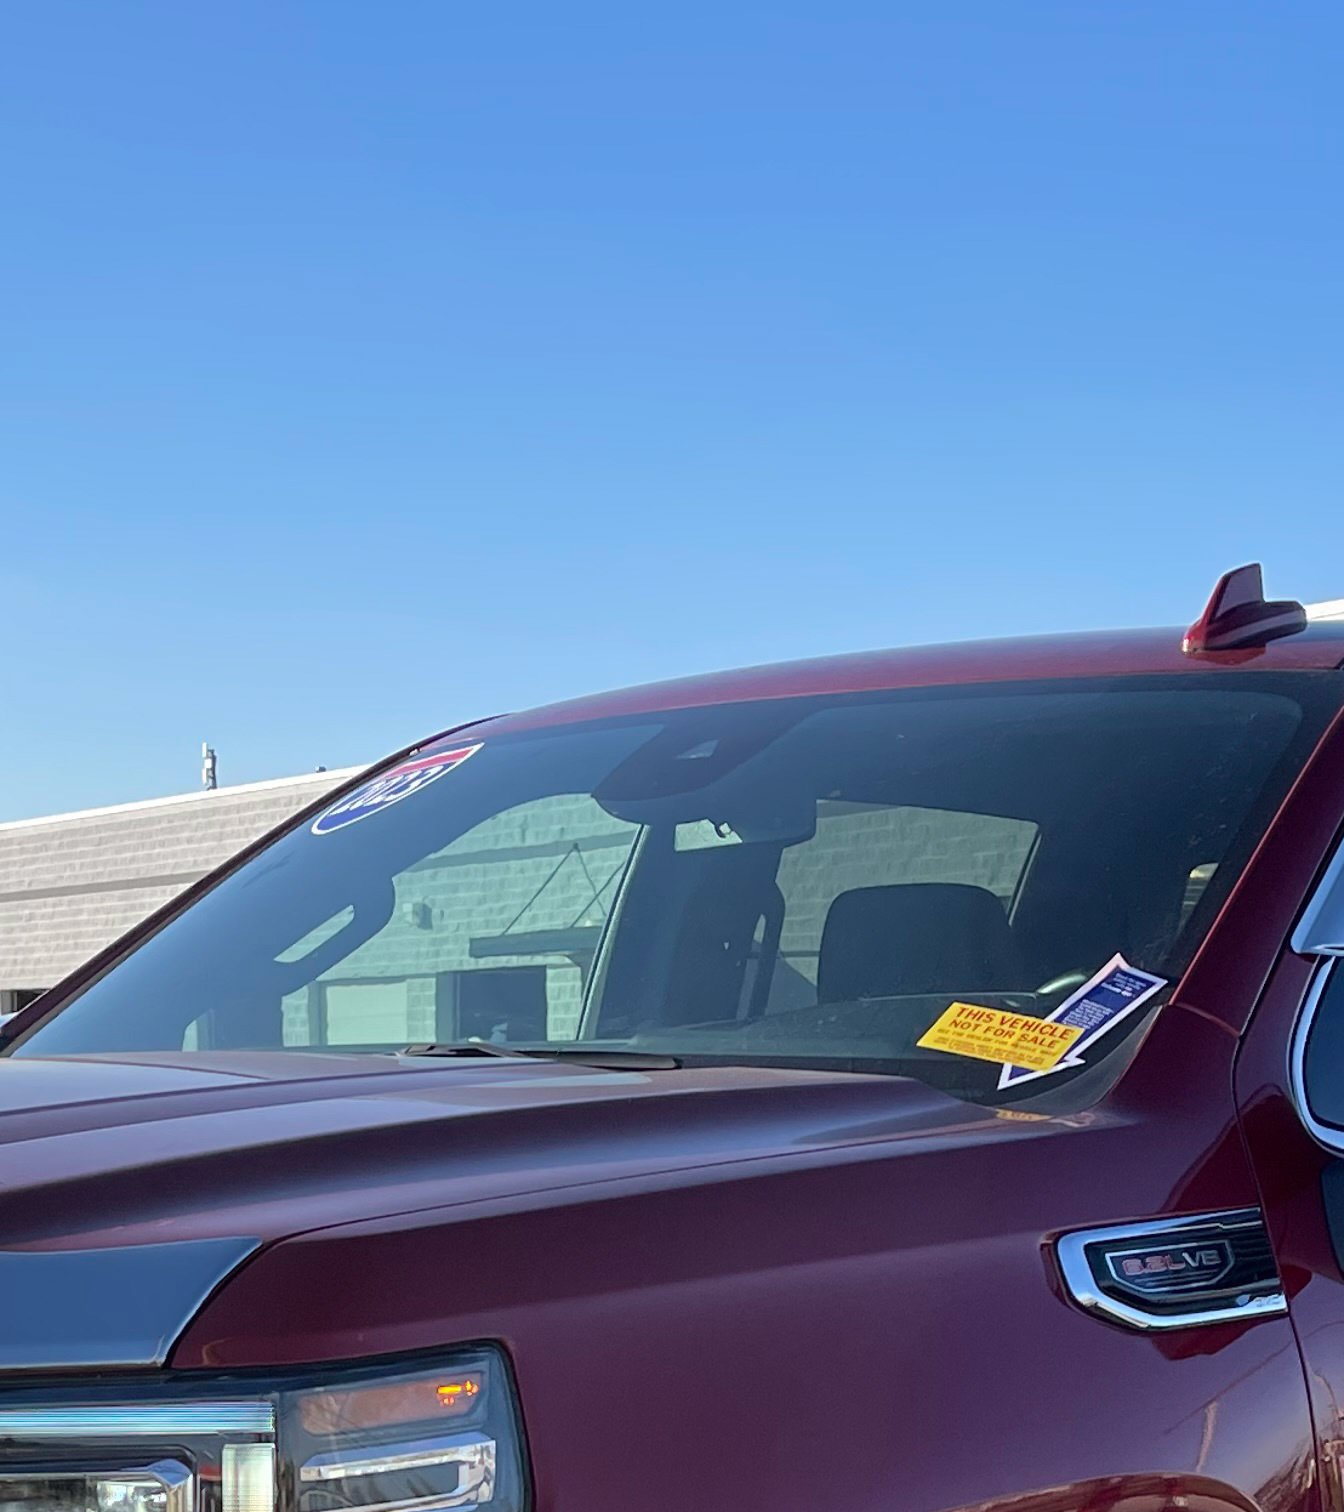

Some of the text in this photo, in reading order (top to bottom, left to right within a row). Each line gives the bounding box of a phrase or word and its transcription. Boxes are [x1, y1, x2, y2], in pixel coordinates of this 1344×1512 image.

[949, 1019, 981, 1032] NOT
[983, 1026, 1015, 1039] FOR
[1017, 1033, 1061, 1049] SALE
[956, 1007, 996, 1024] THIS
[999, 1015, 1075, 1041] VEHICLE
